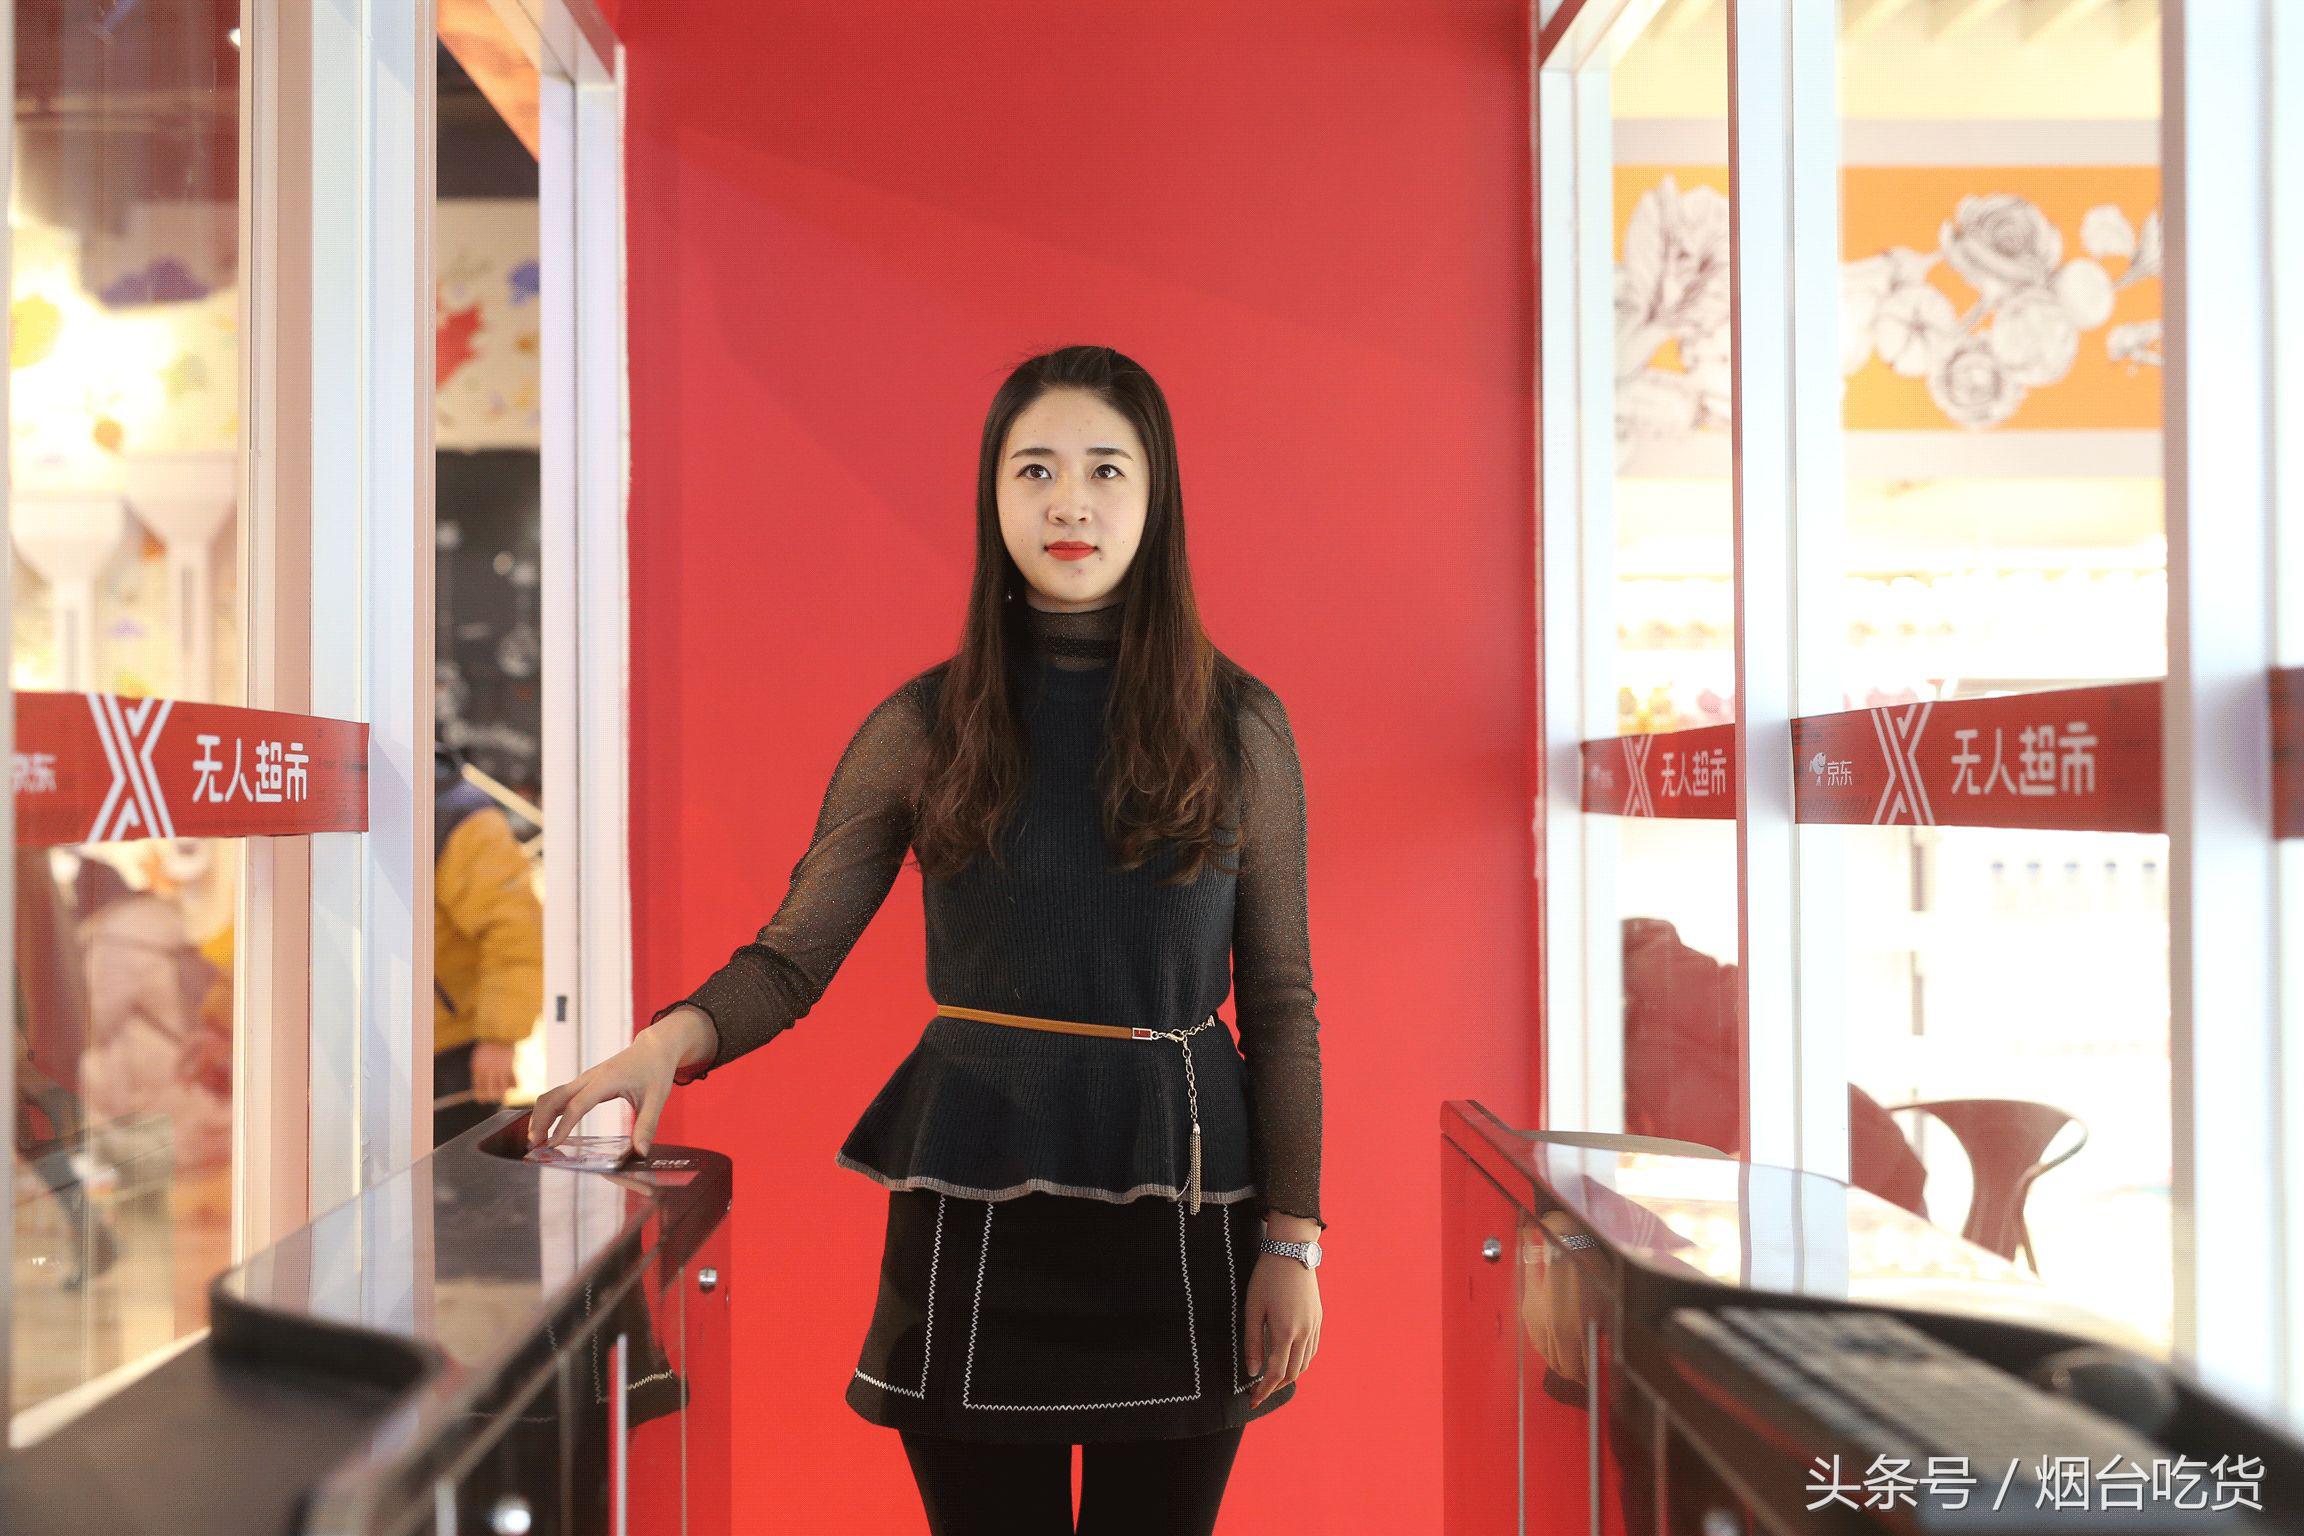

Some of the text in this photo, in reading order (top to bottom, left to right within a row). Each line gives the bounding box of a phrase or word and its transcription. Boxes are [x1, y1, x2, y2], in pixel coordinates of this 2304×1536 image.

[192, 734, 310, 803] 无人超市
[1660, 748, 1727, 798] 无人超市
[1827, 760, 1853, 787] 京东
[1950, 720, 2099, 797] 无人超市
